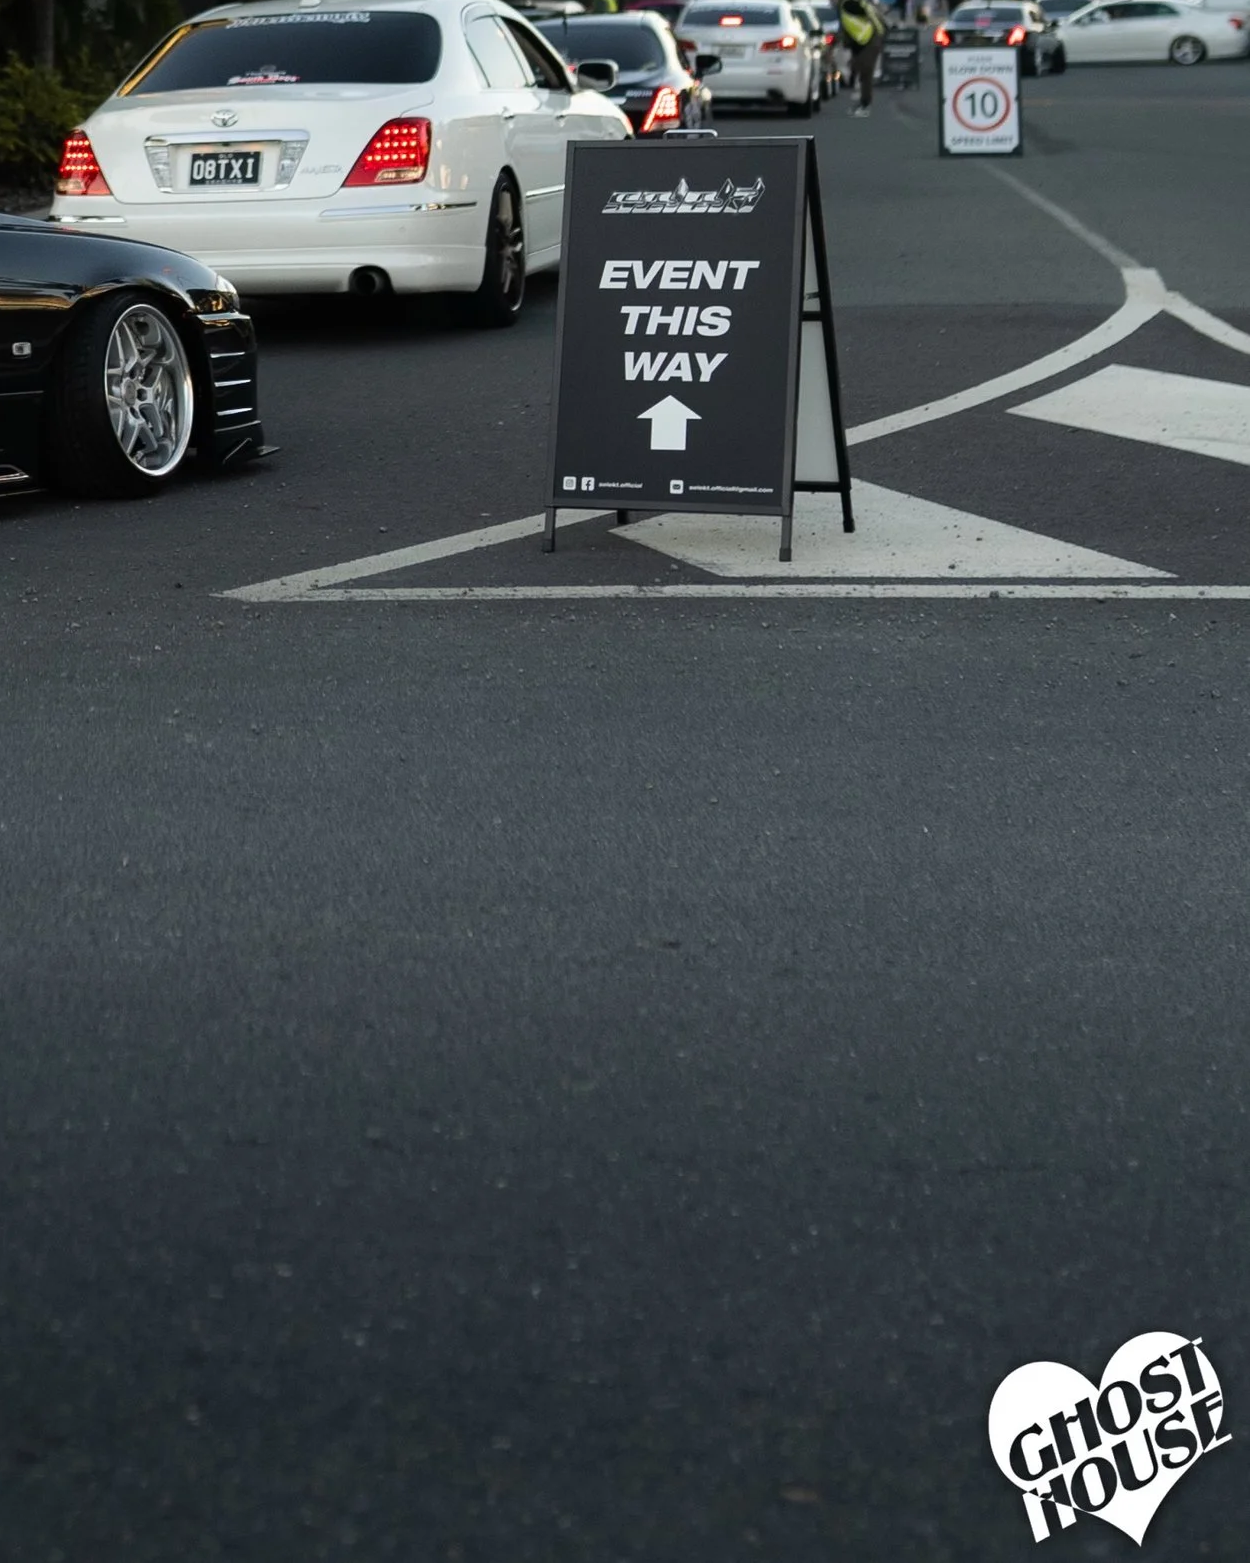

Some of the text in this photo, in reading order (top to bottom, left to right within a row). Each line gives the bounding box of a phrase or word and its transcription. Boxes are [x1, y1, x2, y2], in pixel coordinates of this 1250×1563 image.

[964, 89, 998, 119] 10
[599, 260, 760, 290] EVENT
[620, 305, 732, 337] THIS
[624, 351, 728, 383] WAY
